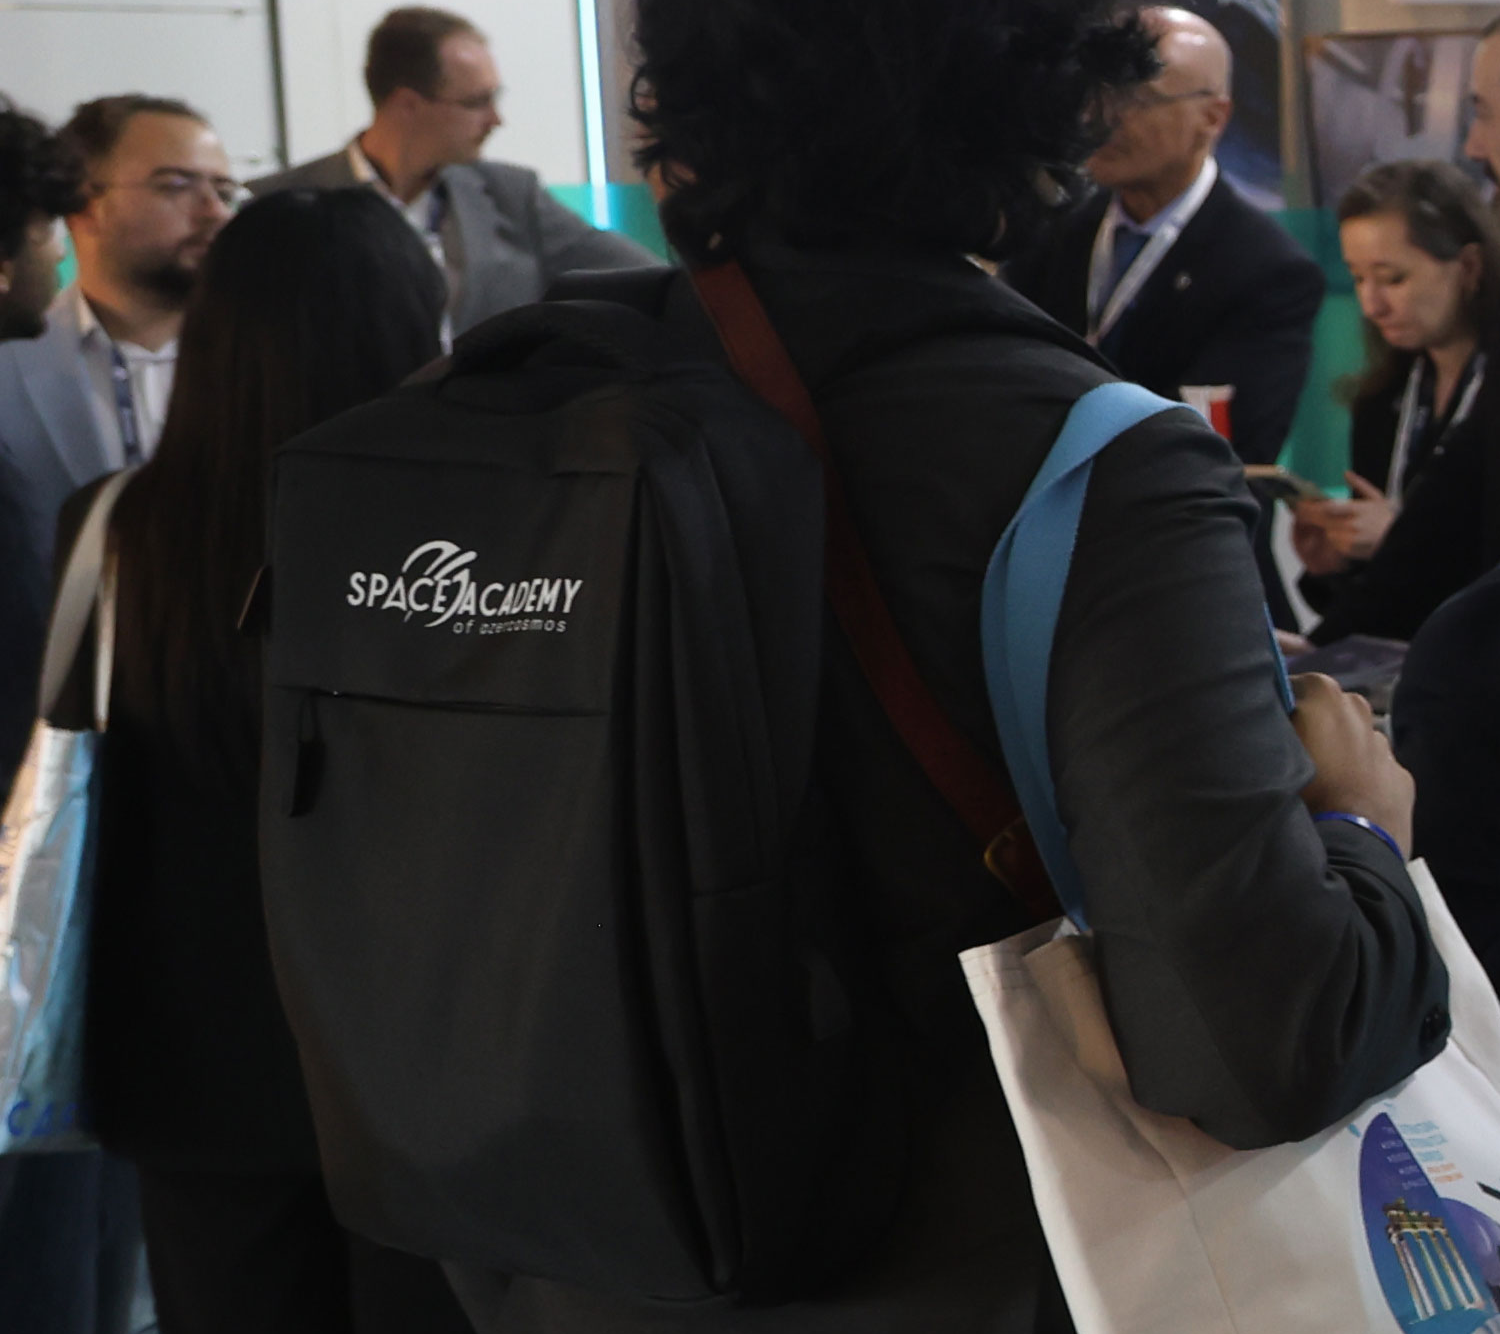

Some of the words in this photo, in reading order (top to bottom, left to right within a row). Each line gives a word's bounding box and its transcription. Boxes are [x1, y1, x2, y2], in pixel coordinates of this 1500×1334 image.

[346, 571, 450, 614] SPACE
[457, 578, 583, 617] ACADEMY
[453, 618, 474, 634] of
